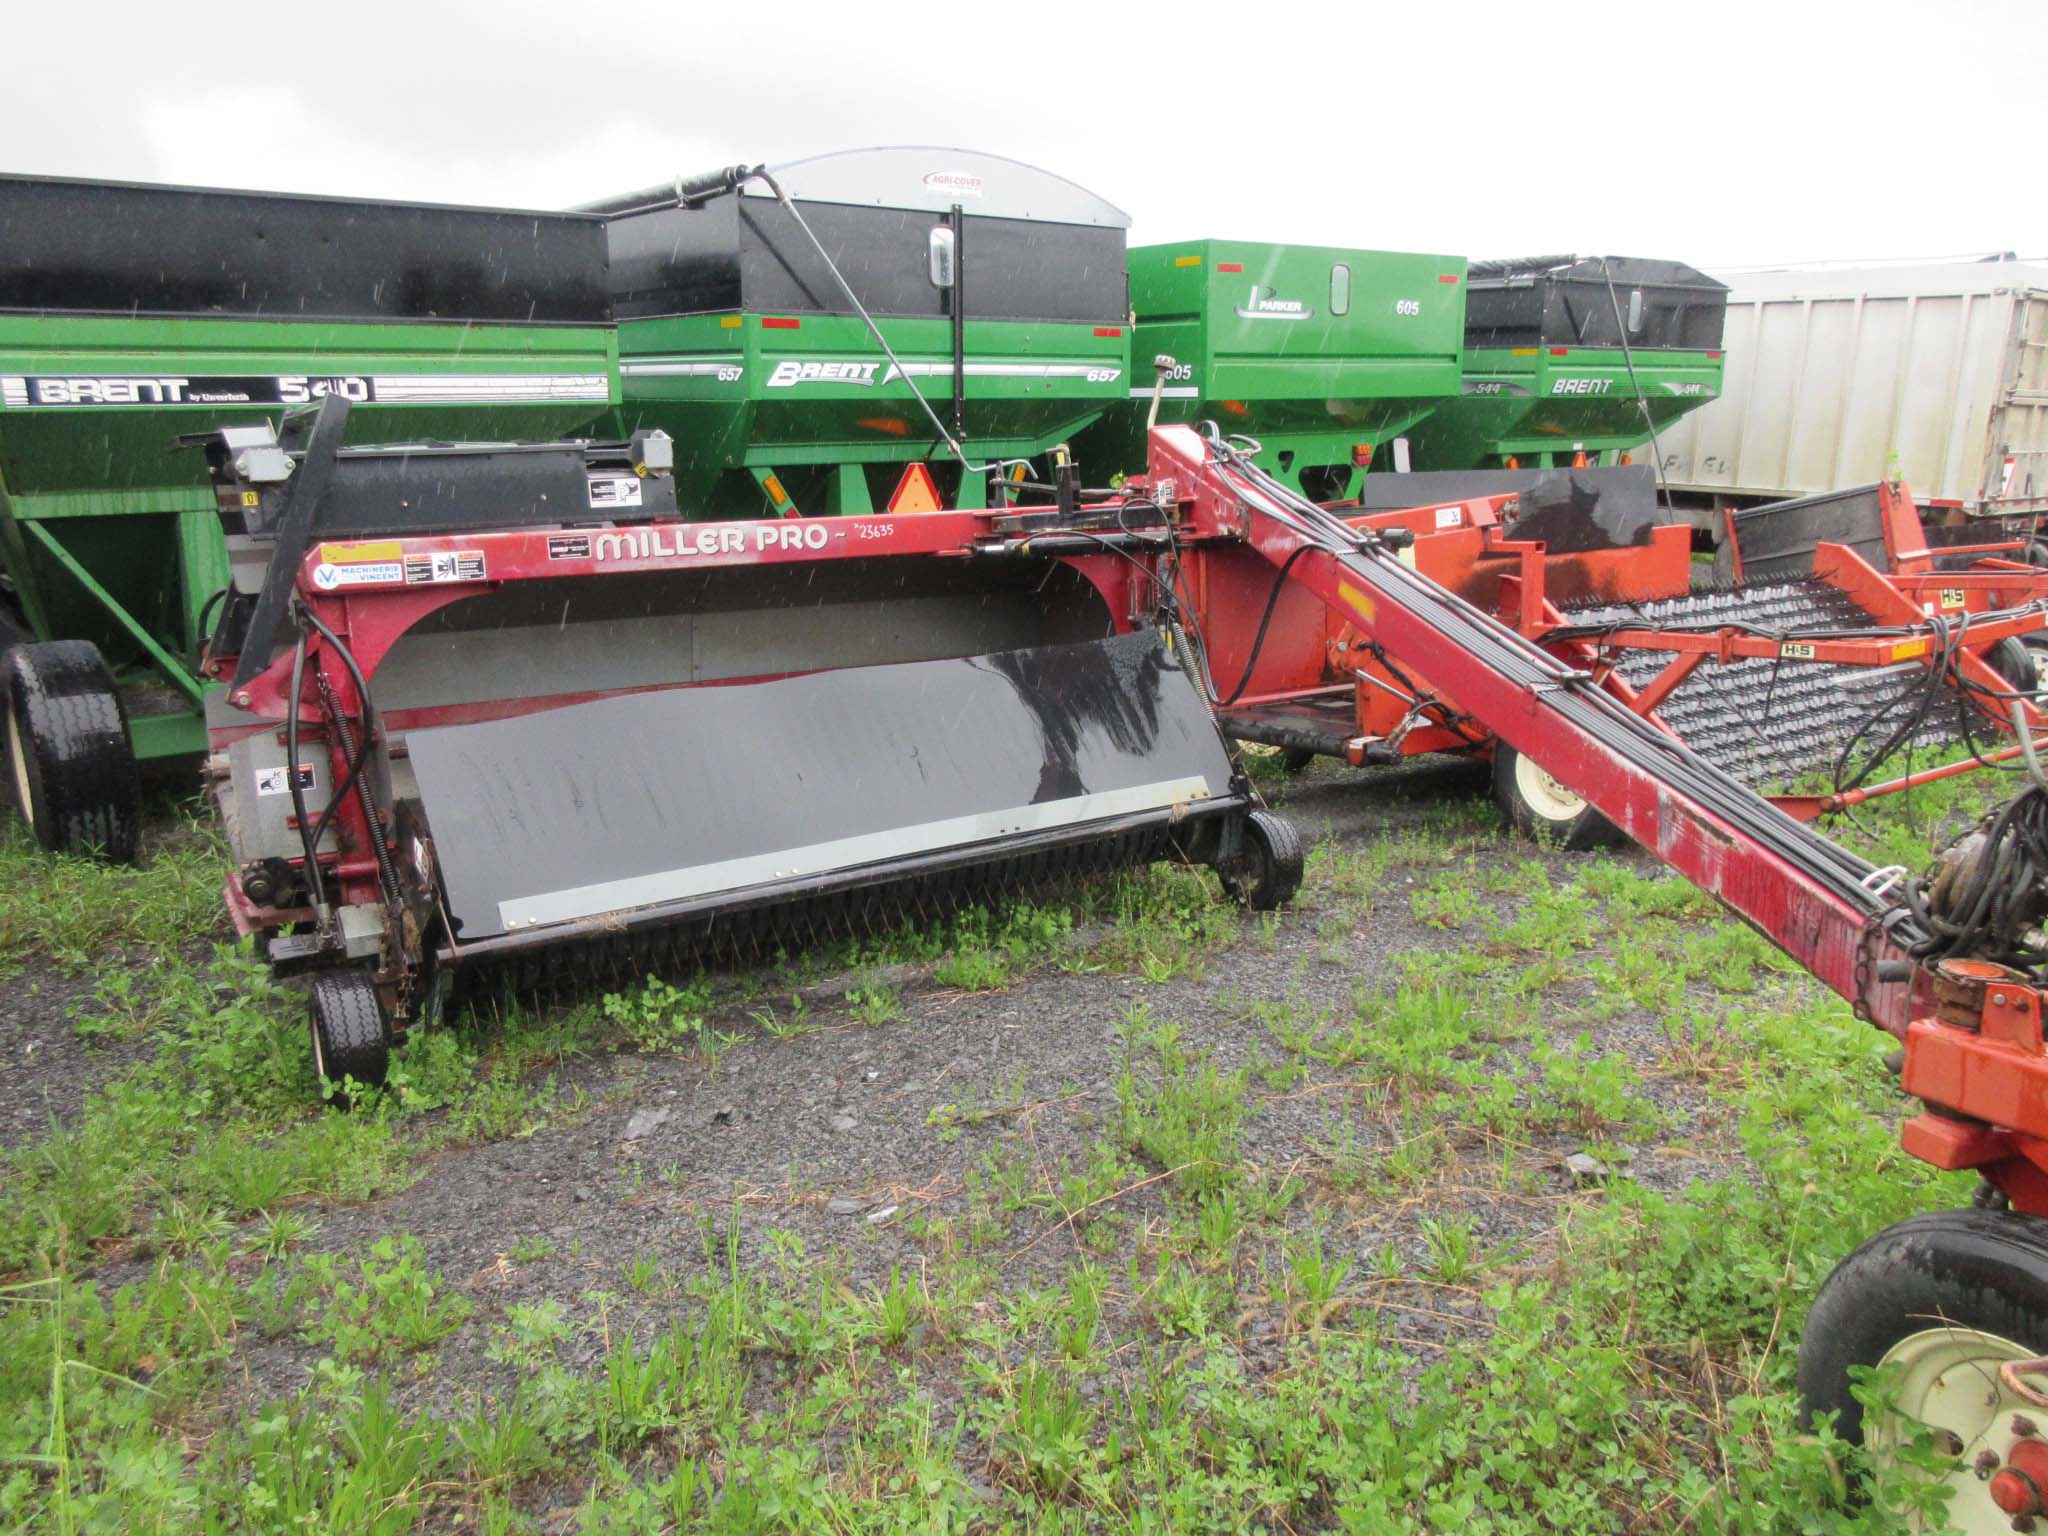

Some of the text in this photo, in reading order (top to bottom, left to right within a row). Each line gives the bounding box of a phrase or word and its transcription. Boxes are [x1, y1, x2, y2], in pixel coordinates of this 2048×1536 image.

[1258, 300, 1303, 313] PARKER
[1396, 299, 1420, 316] 605
[717, 366, 744, 382] 657
[766, 361, 881, 387] BRENT
[1086, 369, 1122, 383] 657
[37, 378, 190, 404] BRENT
[1551, 378, 1615, 395] BRENT
[755, 522, 830, 553] PRO
[340, 565, 400, 576] MACHINERIE
[359, 573, 401, 582] VINCENT
[1941, 589, 1965, 603] H&S
[1783, 644, 1811, 657] H&S
